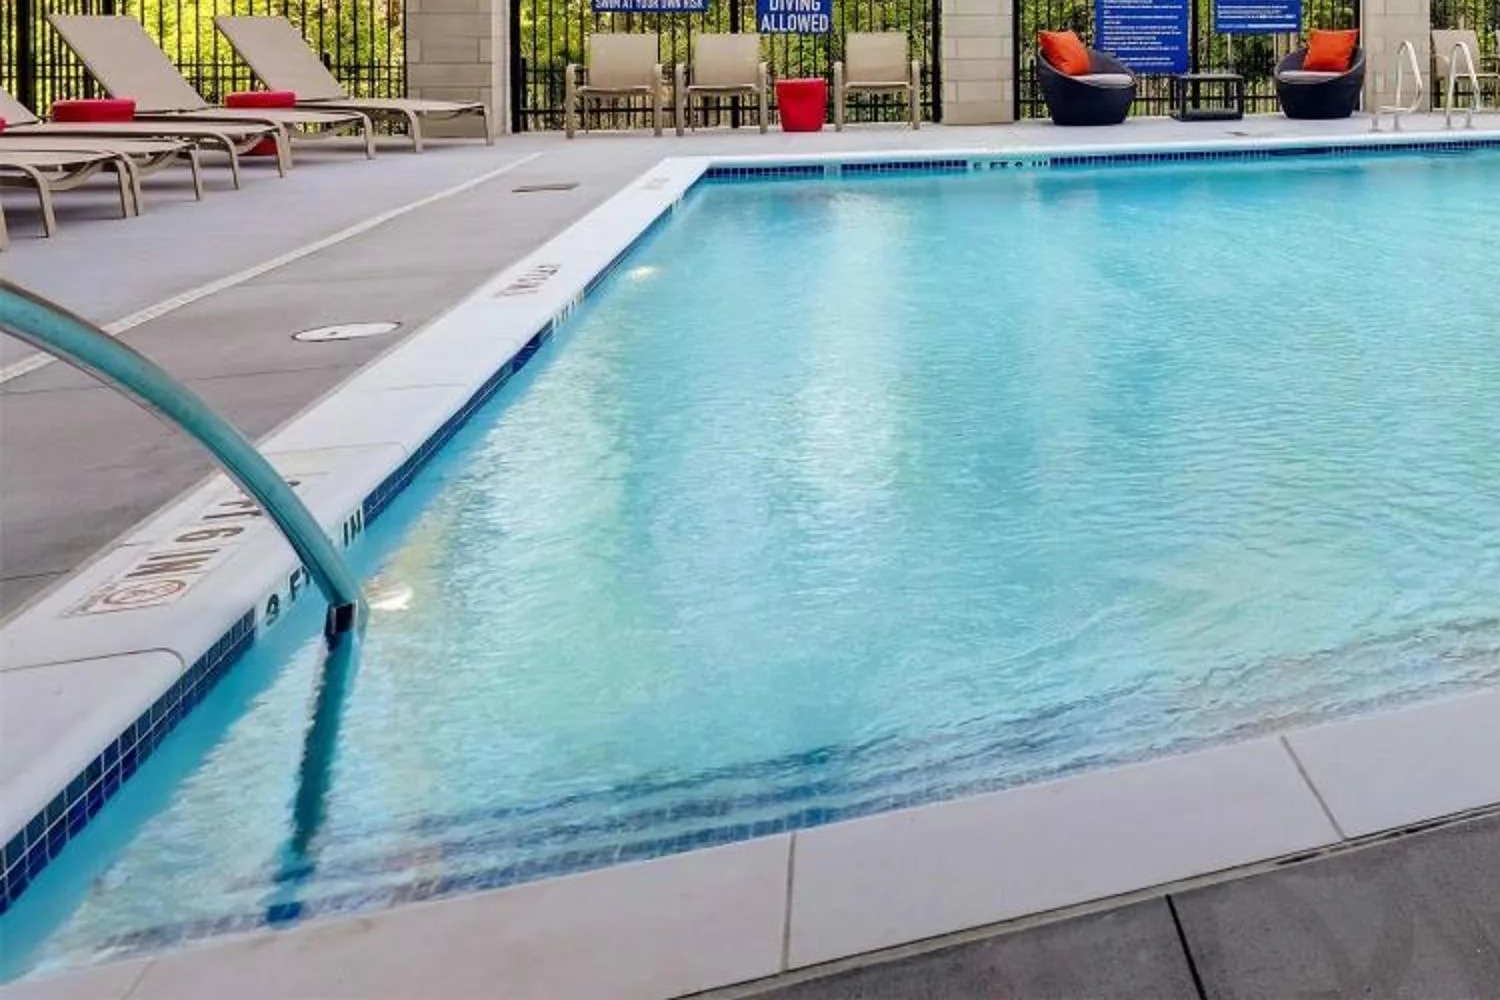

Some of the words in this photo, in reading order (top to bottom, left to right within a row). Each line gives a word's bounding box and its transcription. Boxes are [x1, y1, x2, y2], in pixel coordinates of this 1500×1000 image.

[761, 14, 829, 32] ALLOWED
[175, 526, 244, 543] 6
[343, 508, 363, 547] IN
[125, 548, 220, 578] IN
